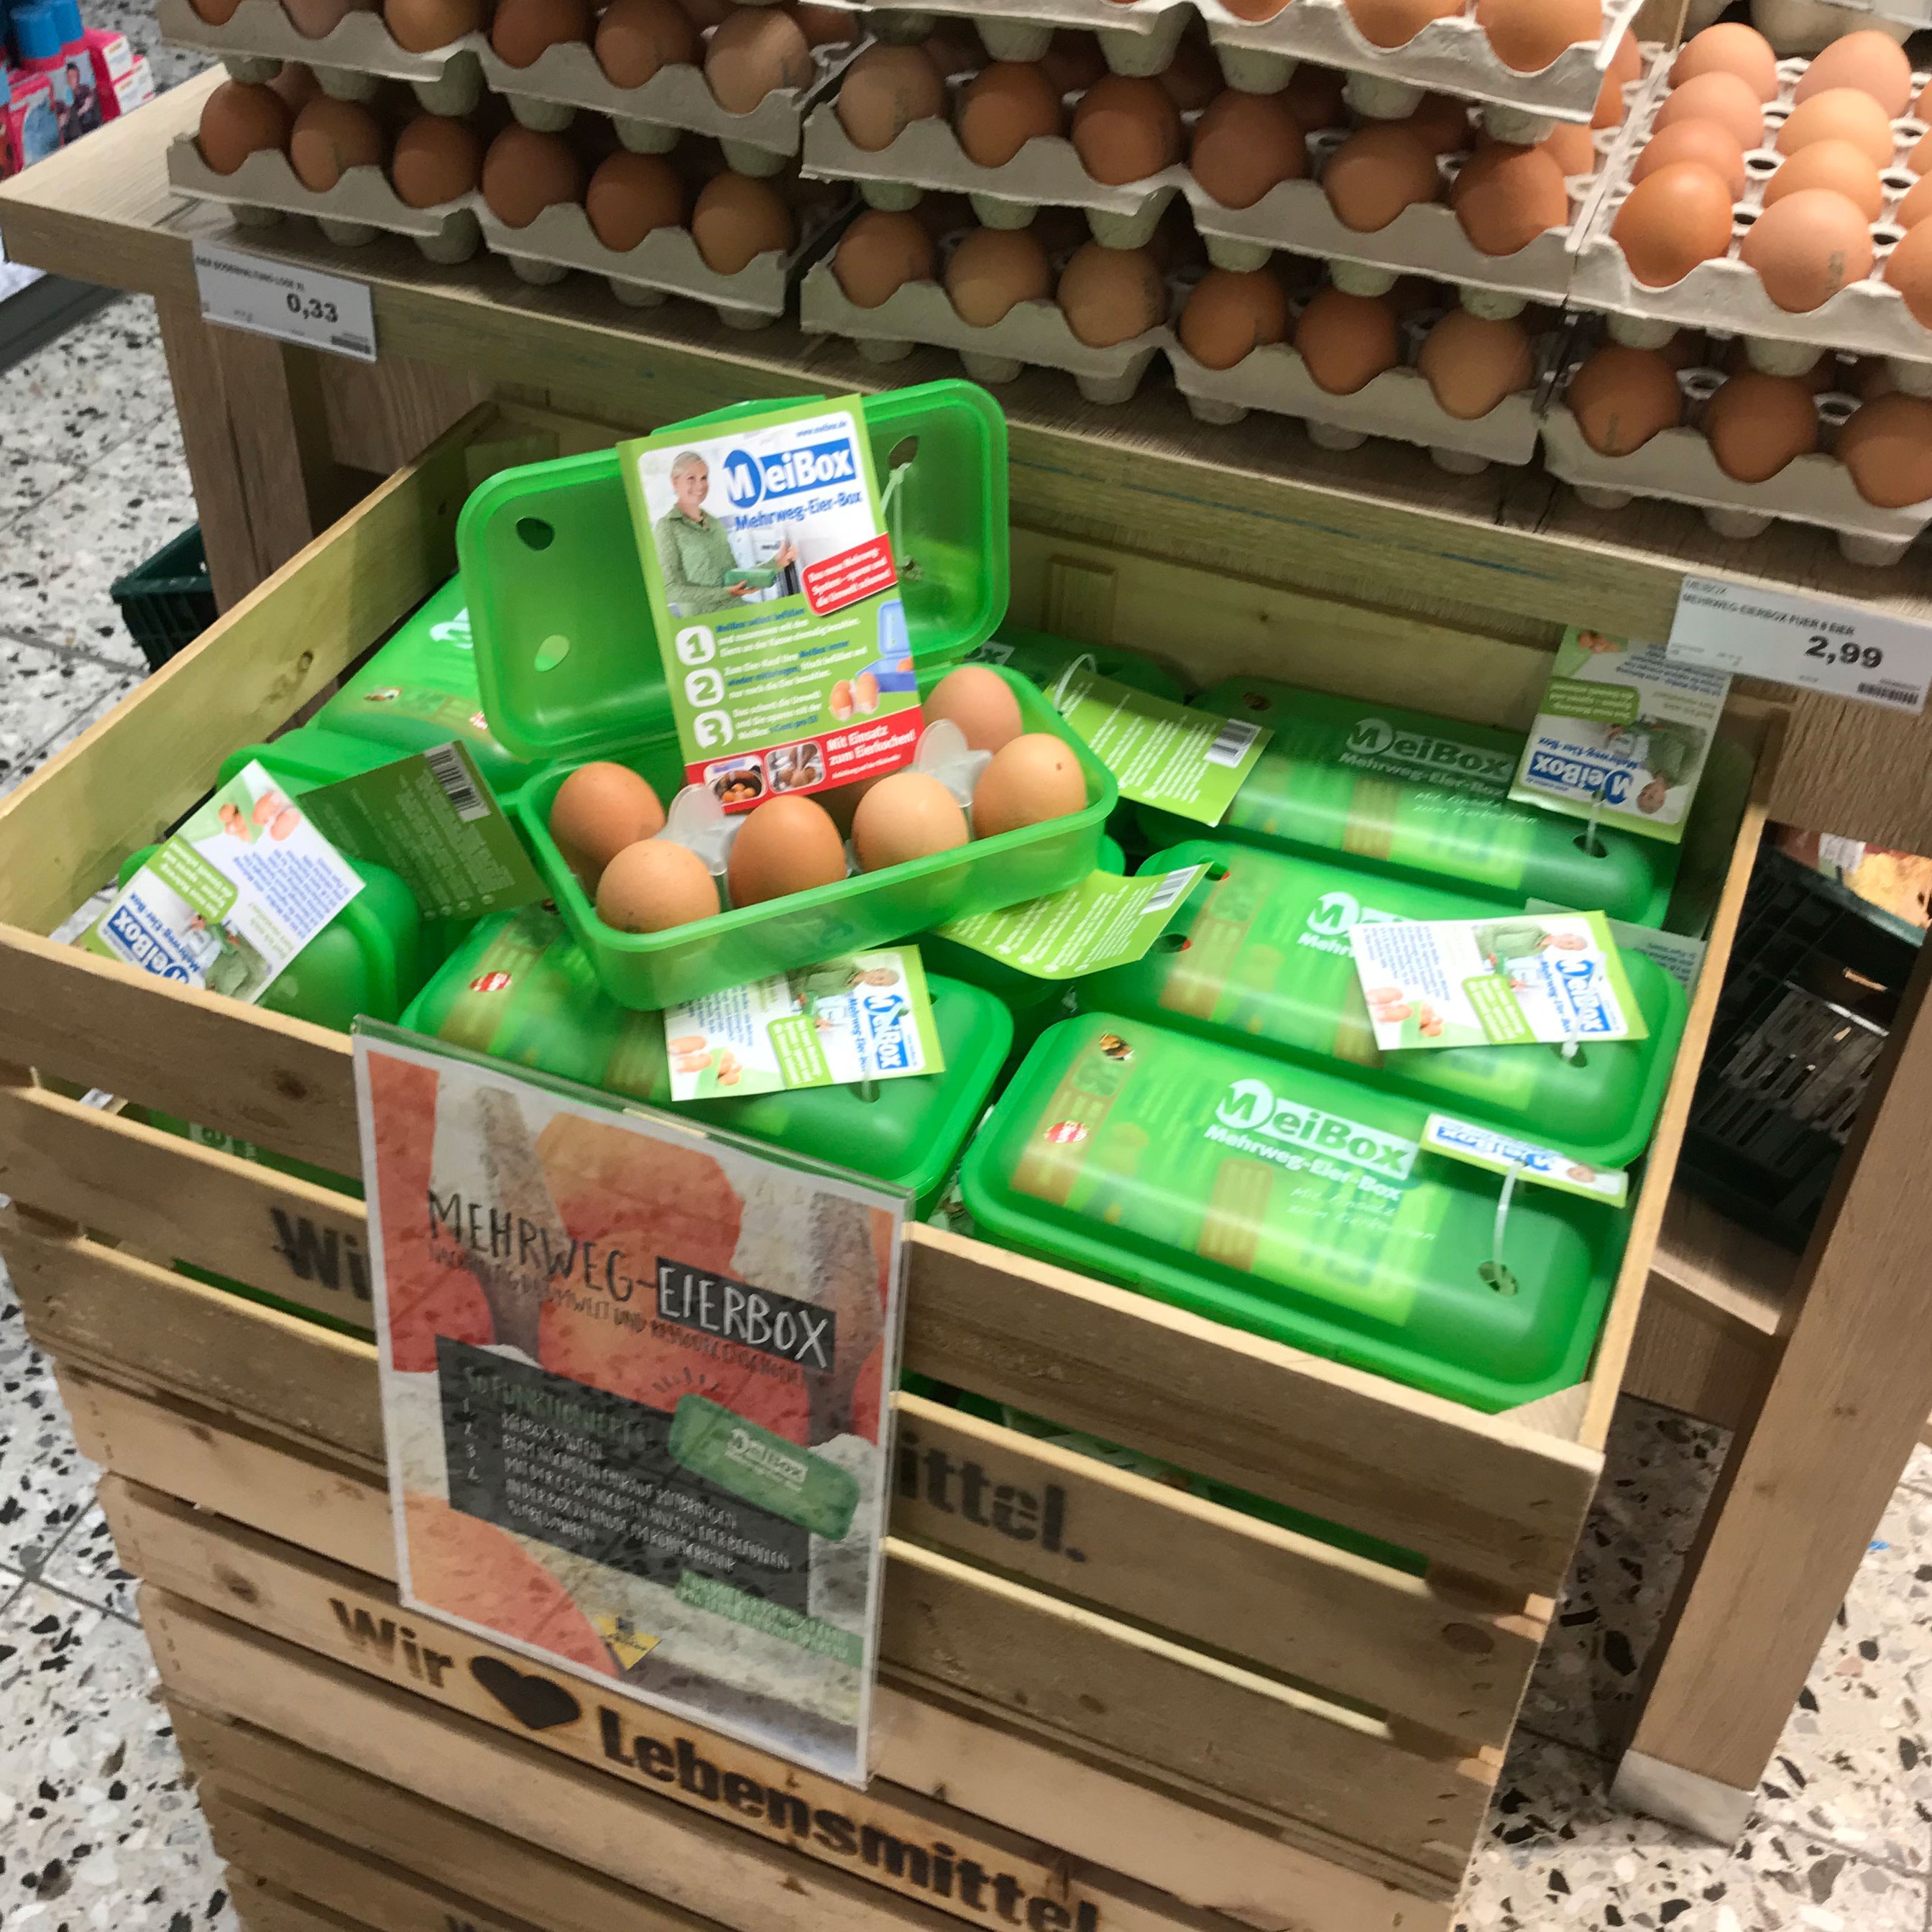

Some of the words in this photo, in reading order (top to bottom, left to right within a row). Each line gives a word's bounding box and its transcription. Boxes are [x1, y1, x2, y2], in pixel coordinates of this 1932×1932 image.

[287, 292, 339, 323] 0,33
[722, 444, 856, 507] MeiBox
[734, 491, 862, 532] Mehrweg-Eier-Box
[1805, 635, 1884, 669] 2,99
[826, 737, 849, 753] Mit
[848, 724, 890, 747] Einsatz
[828, 752, 855, 767] zum
[1346, 719, 1512, 782] MeiBox
[1532, 753, 1633, 804] MeiBox
[1216, 1080, 1414, 1177] MeiBox
[1204, 1124, 1402, 1202] Mehrweg-Eier-Box
[428, 1188, 828, 1368] MEHRWEG-EIERBOX
[328, 1596, 455, 1689] Wir
[597, 1703, 1100, 1932] Lebensmittel
